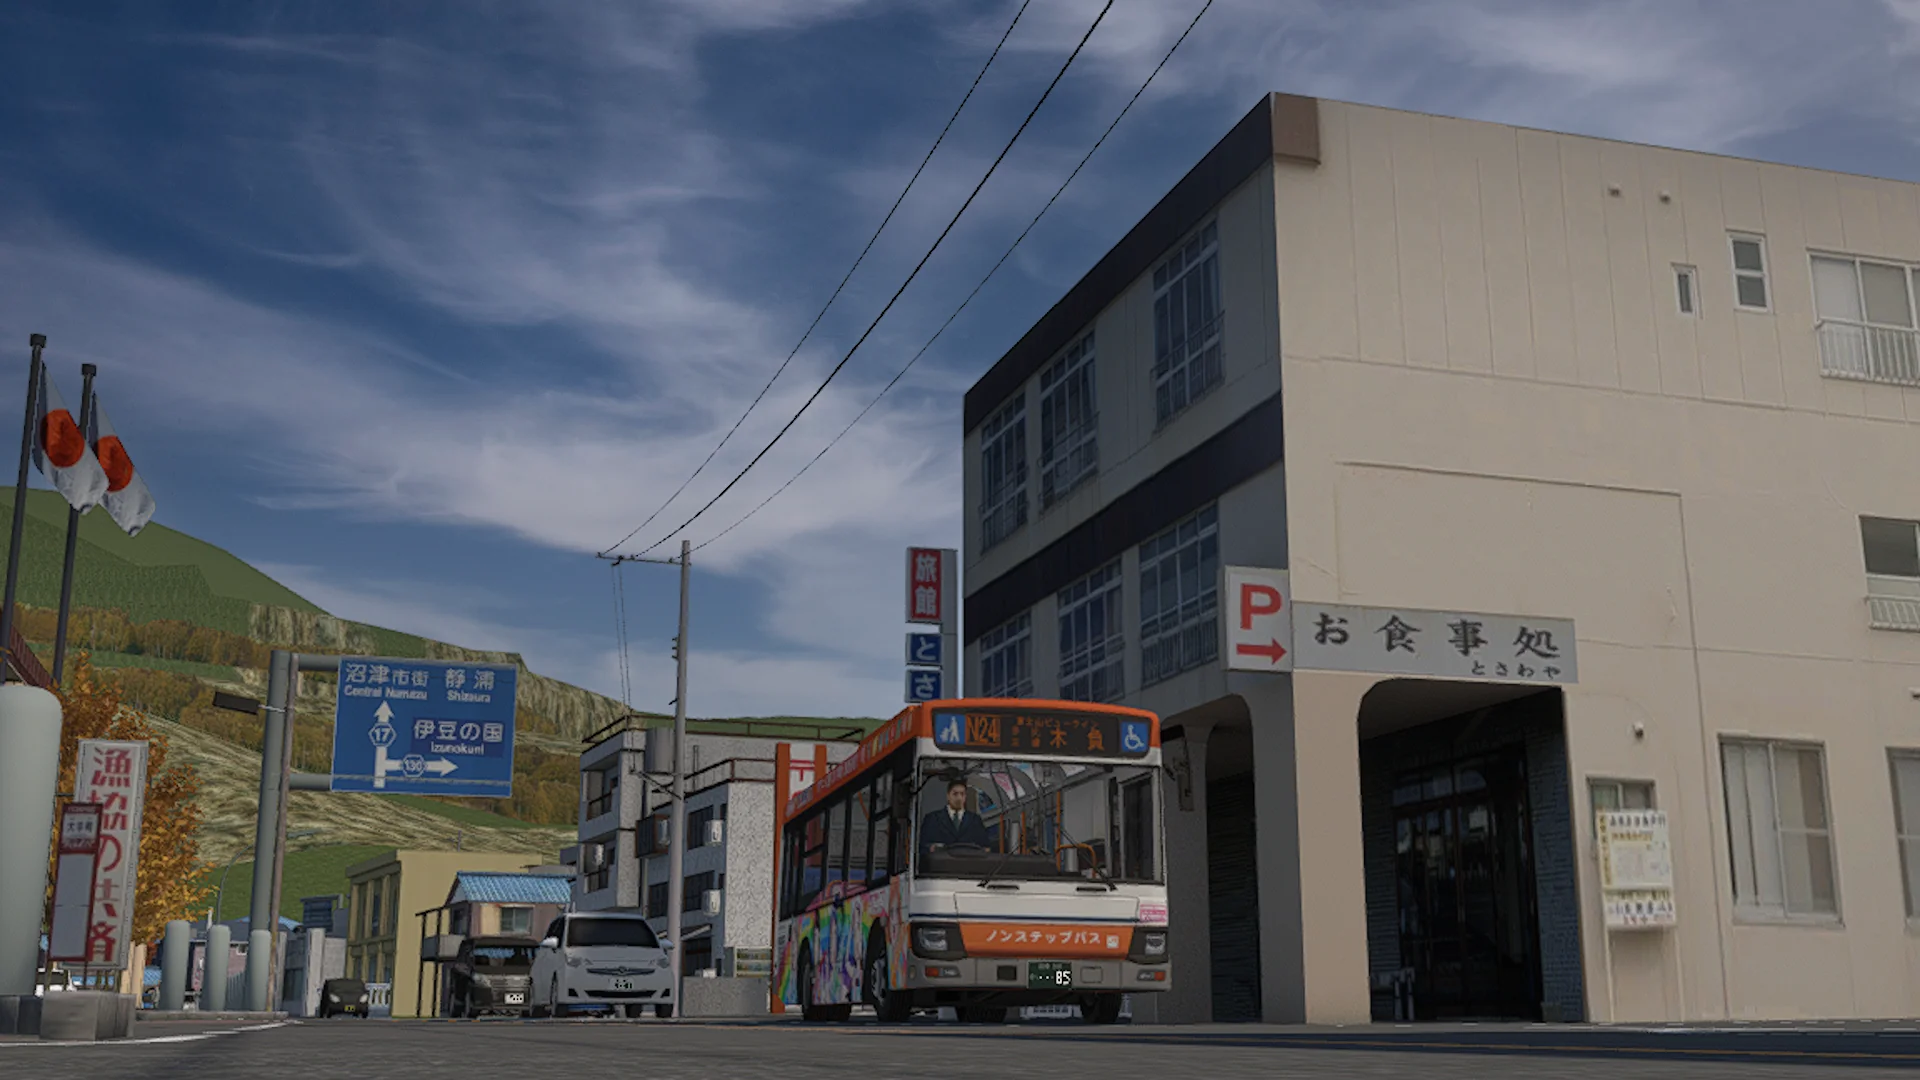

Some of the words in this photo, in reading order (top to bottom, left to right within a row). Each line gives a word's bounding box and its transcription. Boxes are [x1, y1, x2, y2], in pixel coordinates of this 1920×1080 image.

[915, 553, 937, 616] 旅館
[1240, 582, 1282, 630] P
[1313, 611, 1561, 659] お食事処
[345, 662, 429, 687] 沼津市街
[1471, 660, 1561, 679] とさわや
[374, 728, 391, 741] 17
[413, 719, 504, 743] 伊豆の国
[966, 716, 999, 744] N24
[986, 929, 1101, 945] ノンステップバス
